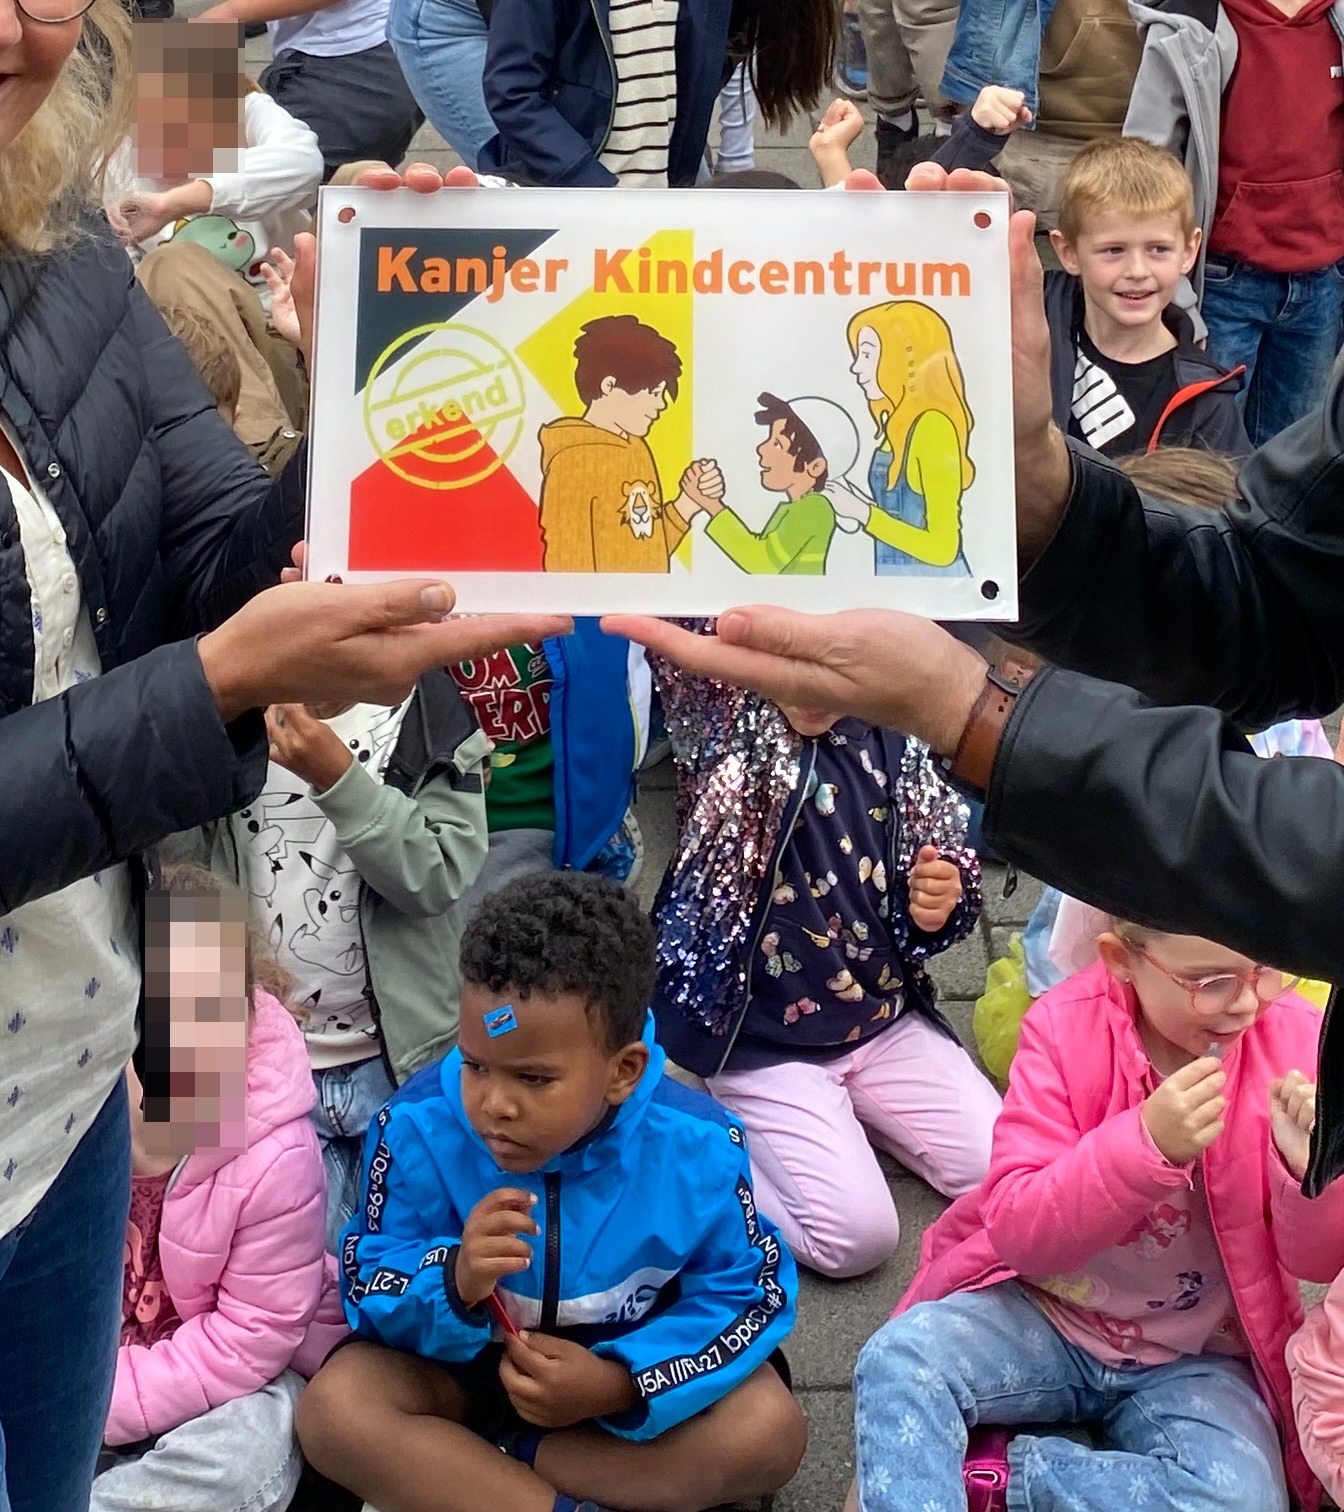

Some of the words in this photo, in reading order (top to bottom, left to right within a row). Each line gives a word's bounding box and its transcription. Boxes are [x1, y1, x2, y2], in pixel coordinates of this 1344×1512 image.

[376, 245, 568, 305] Kanjer
[593, 247, 971, 297] Kindcentrum
[384, 378, 509, 442] erkend
